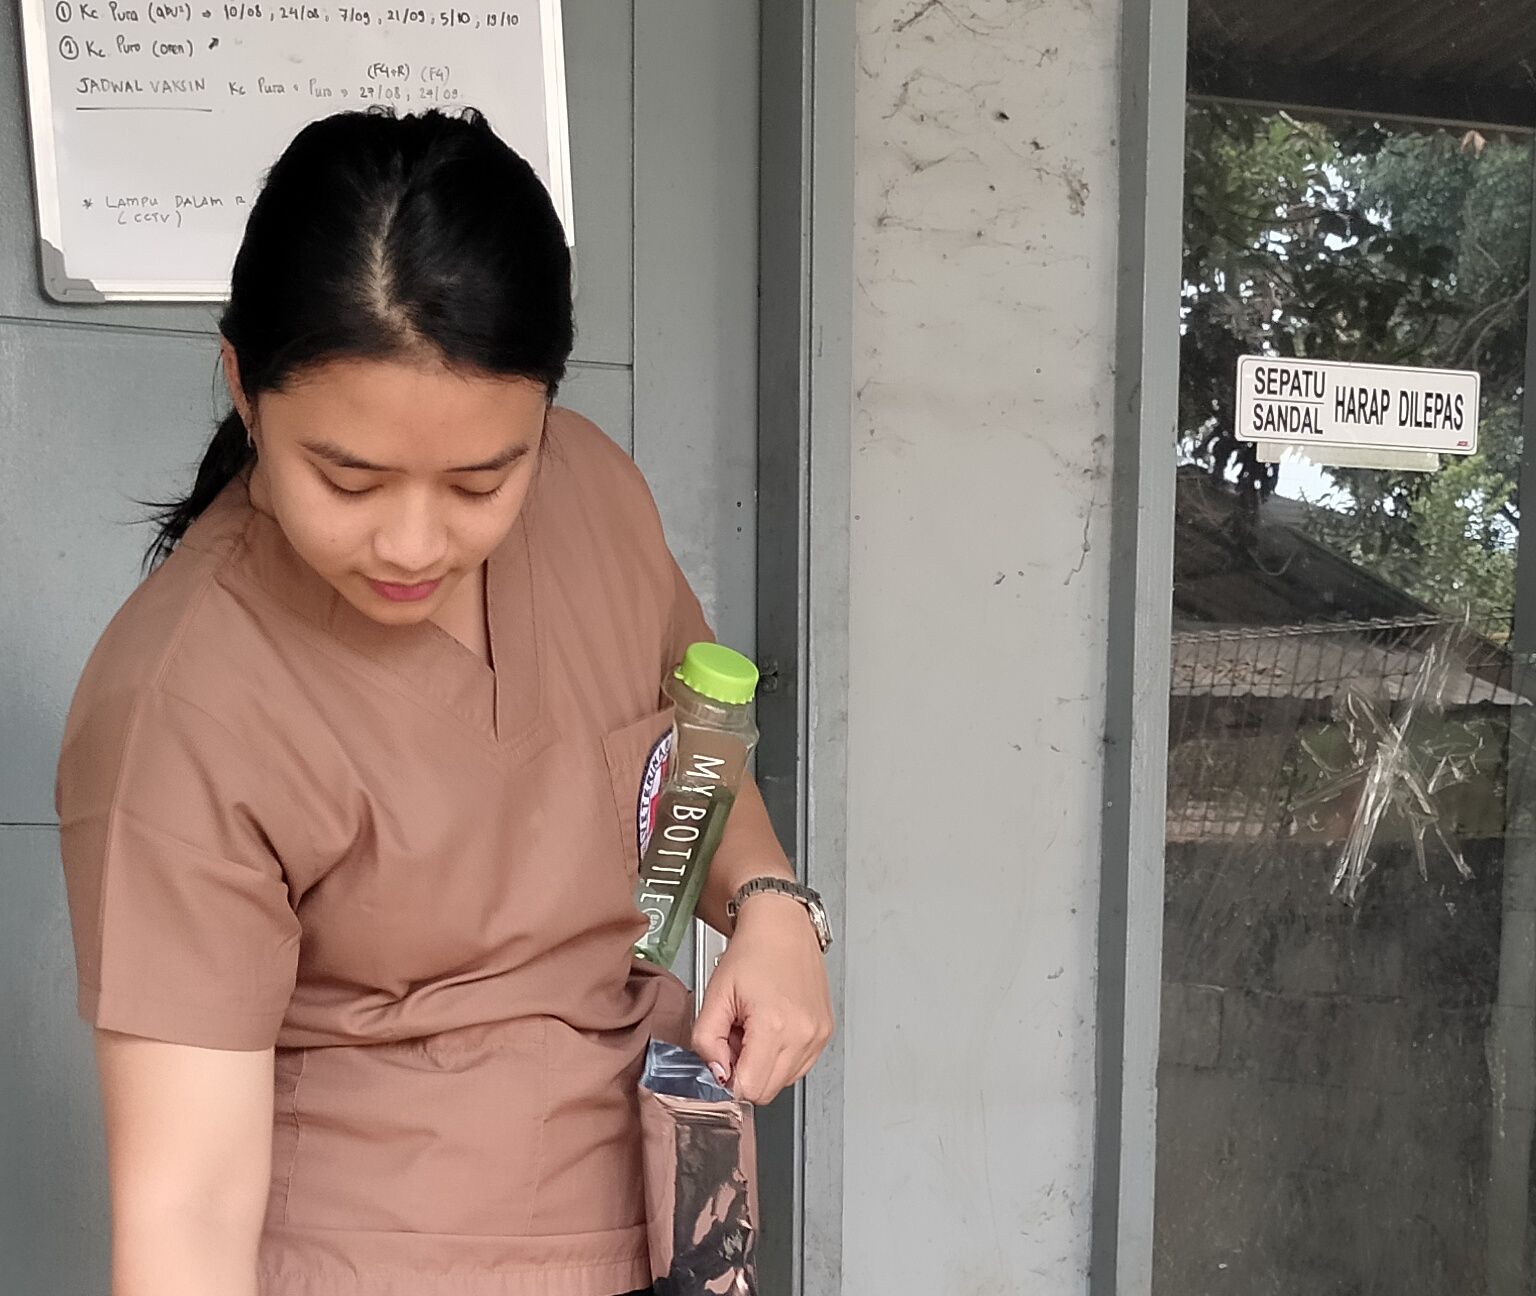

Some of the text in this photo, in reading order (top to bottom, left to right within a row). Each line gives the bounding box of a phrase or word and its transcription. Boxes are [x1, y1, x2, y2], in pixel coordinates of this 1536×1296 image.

[76, 76, 206, 94] JADWAL VAKSIN
[106, 195, 159, 208] LAMPU
[175, 195, 223, 208] DALAM
[1255, 366, 1326, 399] SEPATU
[1253, 403, 1323, 434] SANDAL
[1335, 385, 1464, 431] HARAP DILEPAS
[683, 754, 725, 796] MY
[640, 804, 707, 903] BOTTLE
